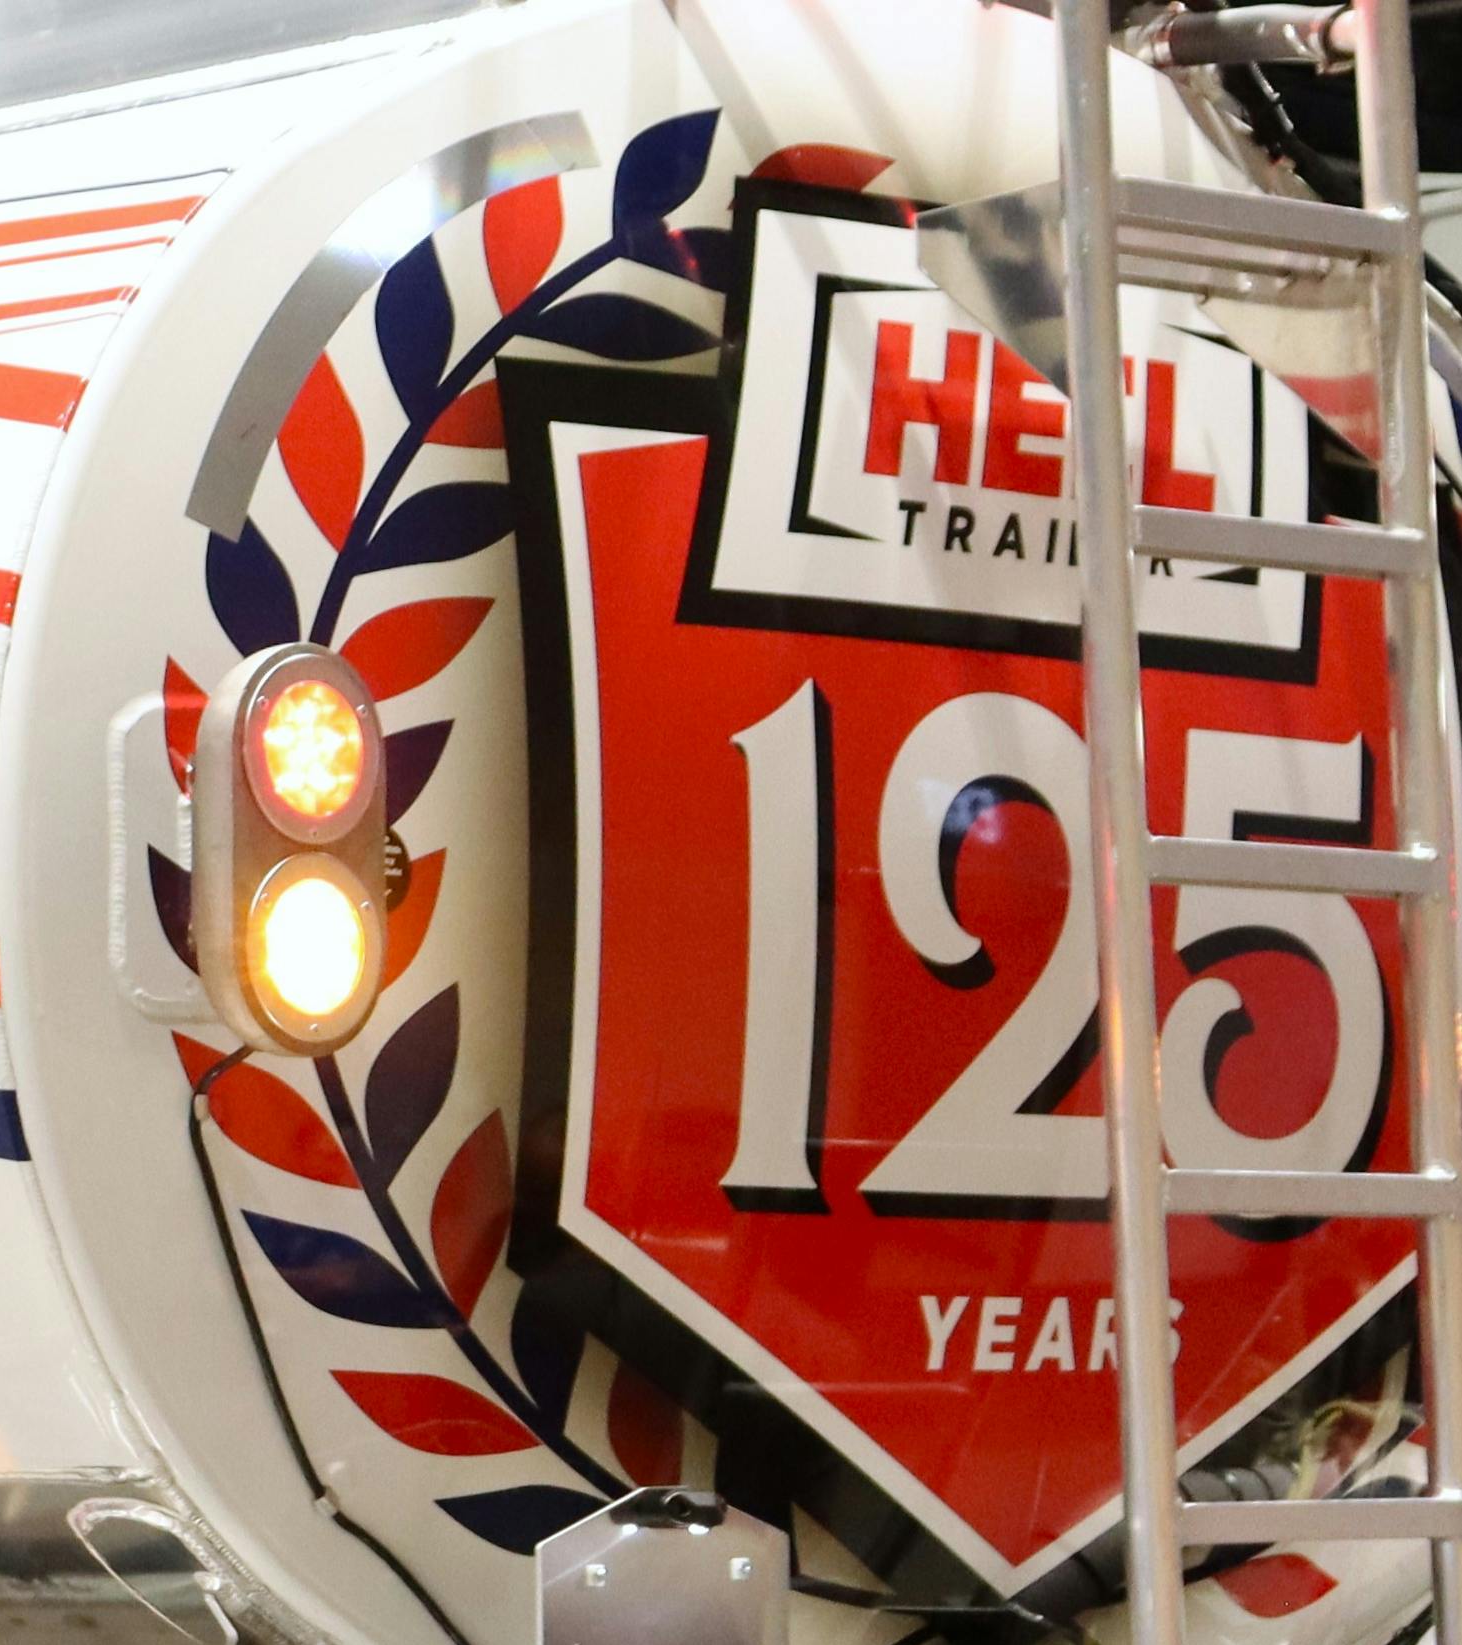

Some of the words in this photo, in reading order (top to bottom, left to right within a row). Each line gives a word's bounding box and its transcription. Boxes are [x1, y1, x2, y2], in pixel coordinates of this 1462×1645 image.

[863, 319, 1216, 513] HEL
[898, 499, 1173, 578] TRAI
[720, 678, 1391, 1225] 125
